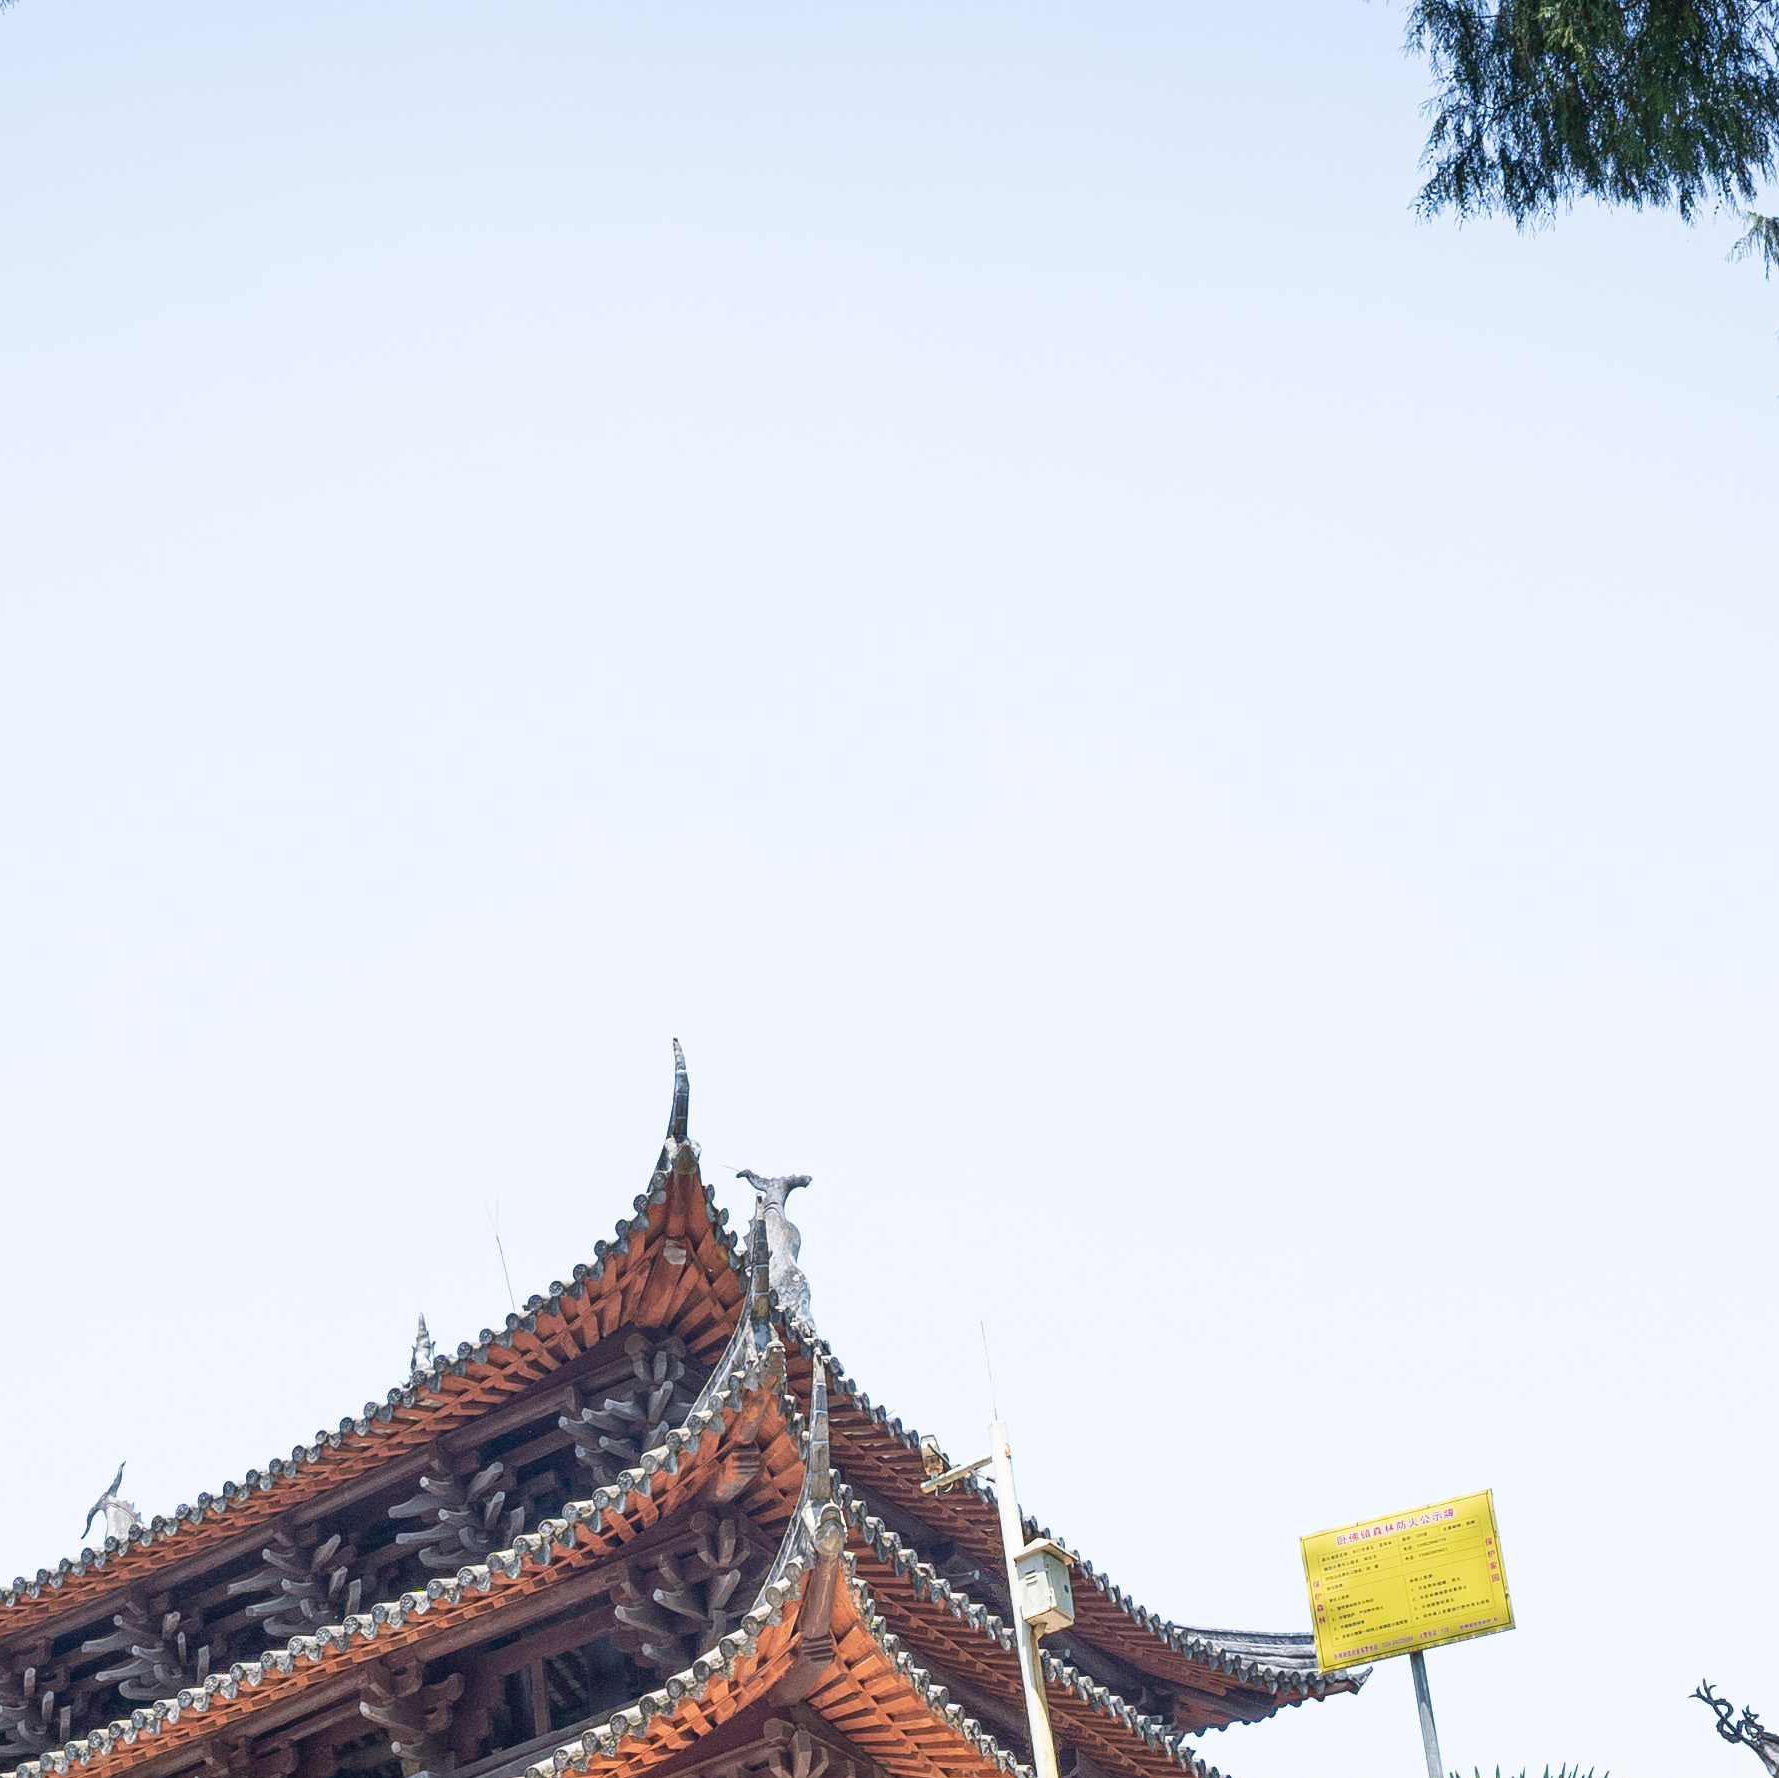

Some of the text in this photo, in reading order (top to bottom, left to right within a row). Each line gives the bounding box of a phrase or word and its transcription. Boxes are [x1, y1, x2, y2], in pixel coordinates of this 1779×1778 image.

[1336, 1508, 1455, 1546] 卧佛镇森林防火公示牌
